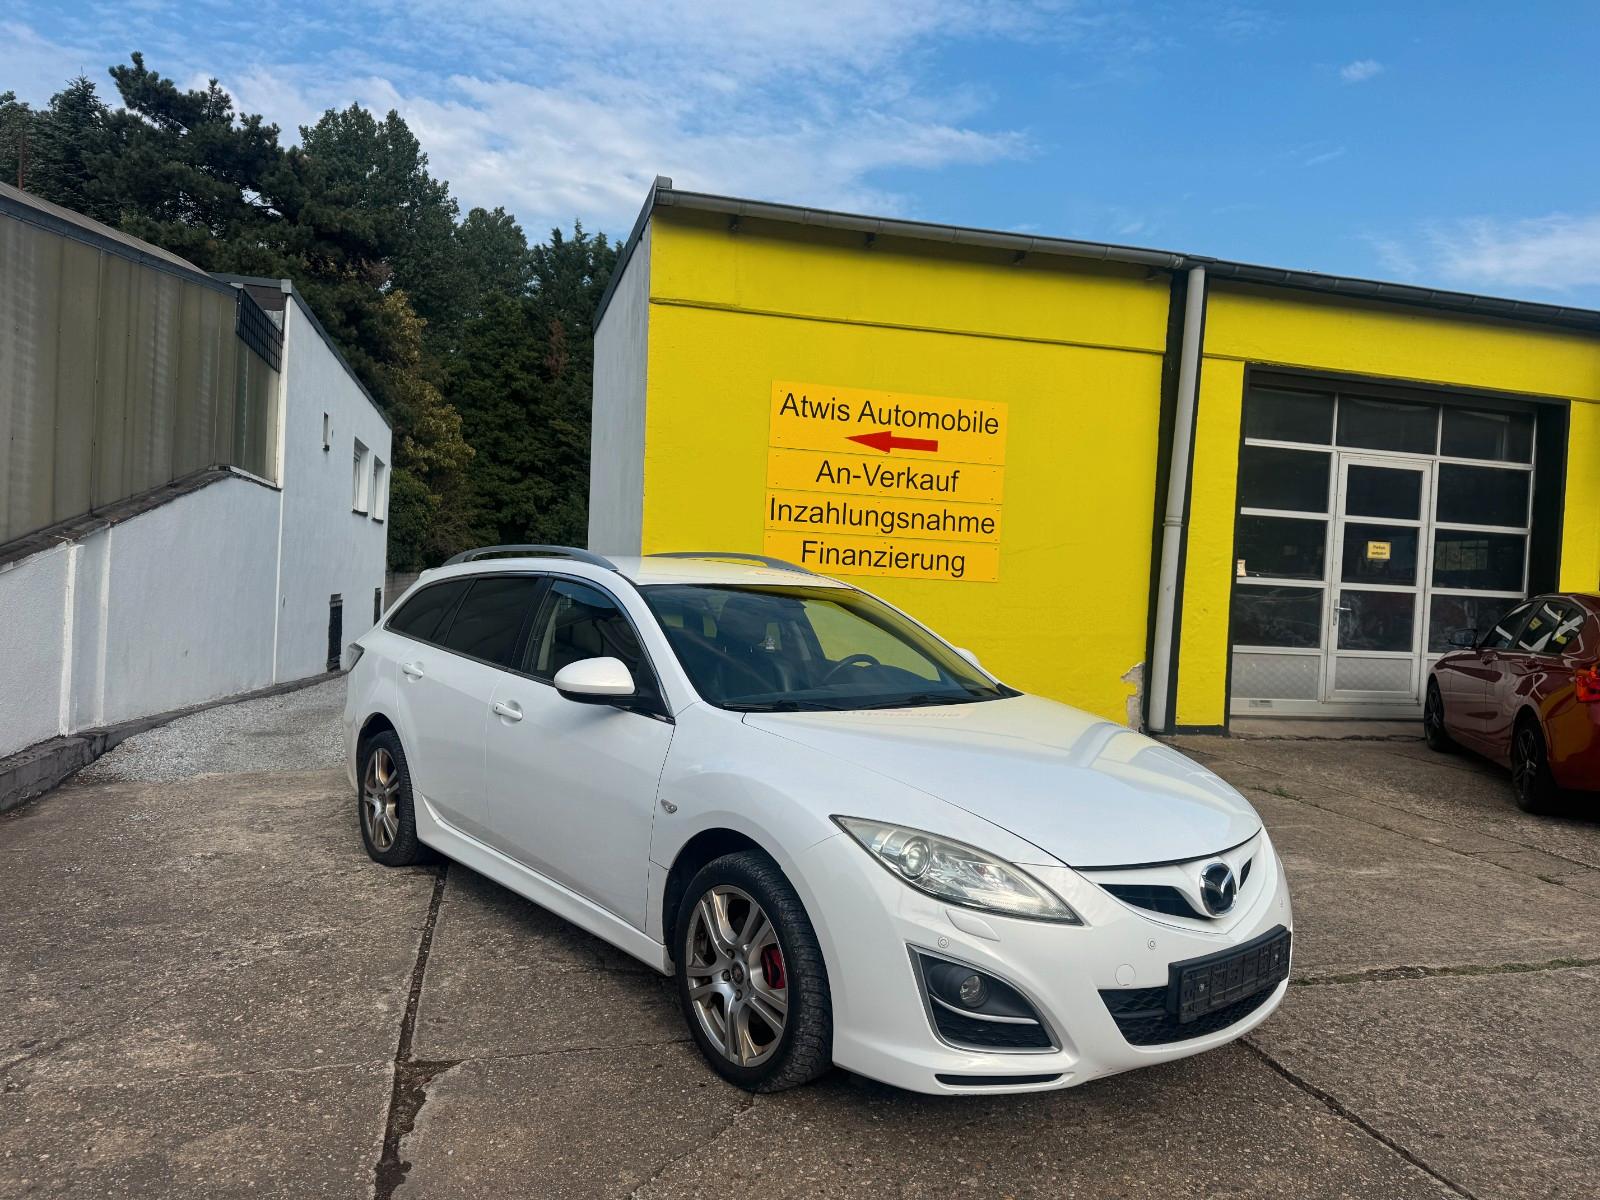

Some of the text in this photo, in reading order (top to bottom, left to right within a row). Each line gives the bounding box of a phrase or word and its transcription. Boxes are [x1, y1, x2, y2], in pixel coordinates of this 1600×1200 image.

[779, 392, 999, 434] Atwis Automobile
[815, 460, 960, 492] An-Verkauf
[770, 497, 995, 534] Inzahlungsnahme
[801, 540, 965, 577] Finanzierung
